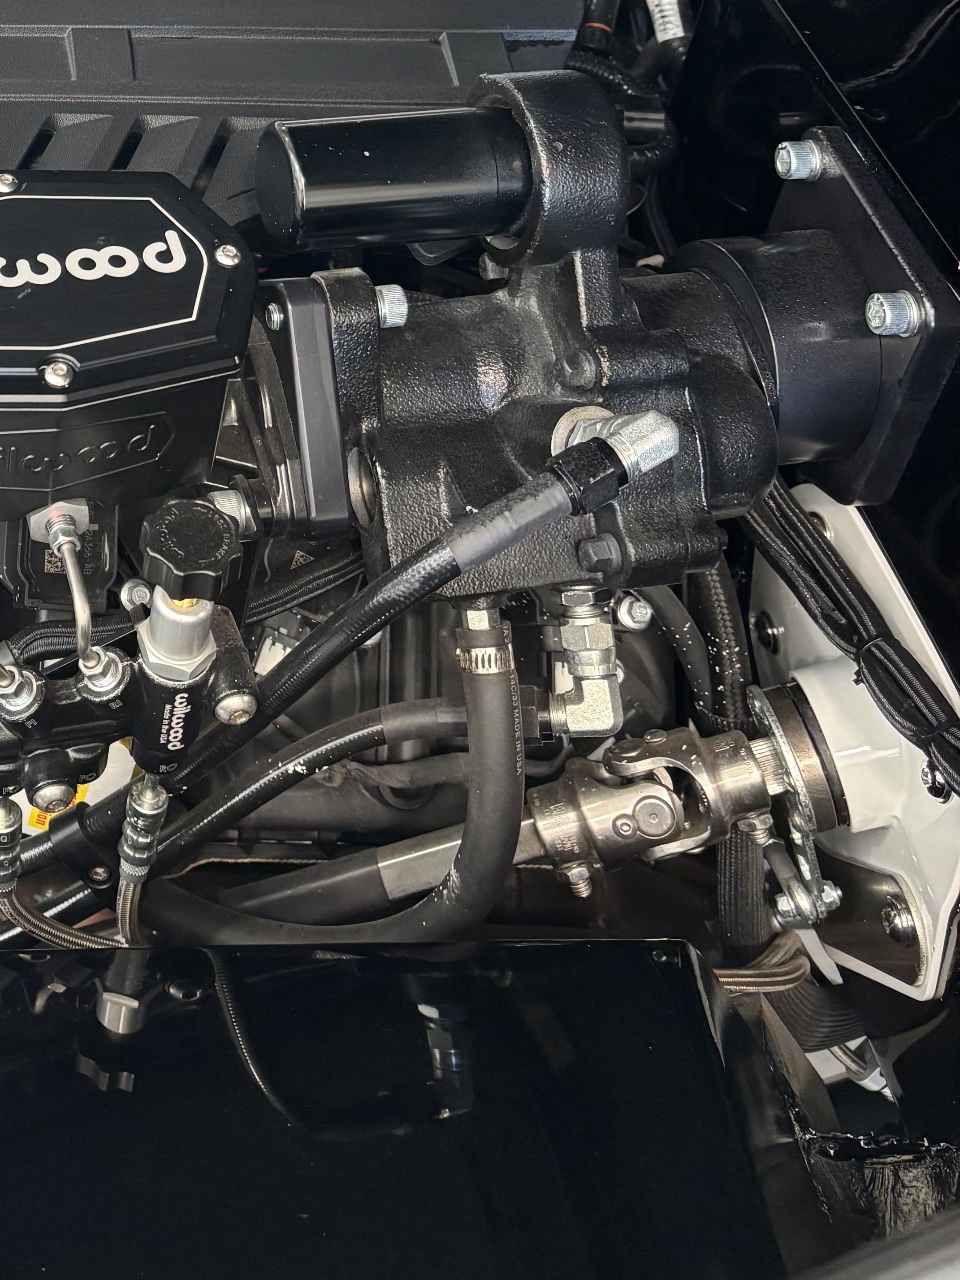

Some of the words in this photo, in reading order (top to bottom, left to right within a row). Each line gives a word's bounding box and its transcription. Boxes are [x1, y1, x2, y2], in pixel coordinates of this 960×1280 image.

[163, 704, 172, 719] Made
[167, 692, 192, 751] wilwood
[512, 709, 521, 738] MADE
[160, 725, 170, 734] the
[159, 733, 168, 744] USA
